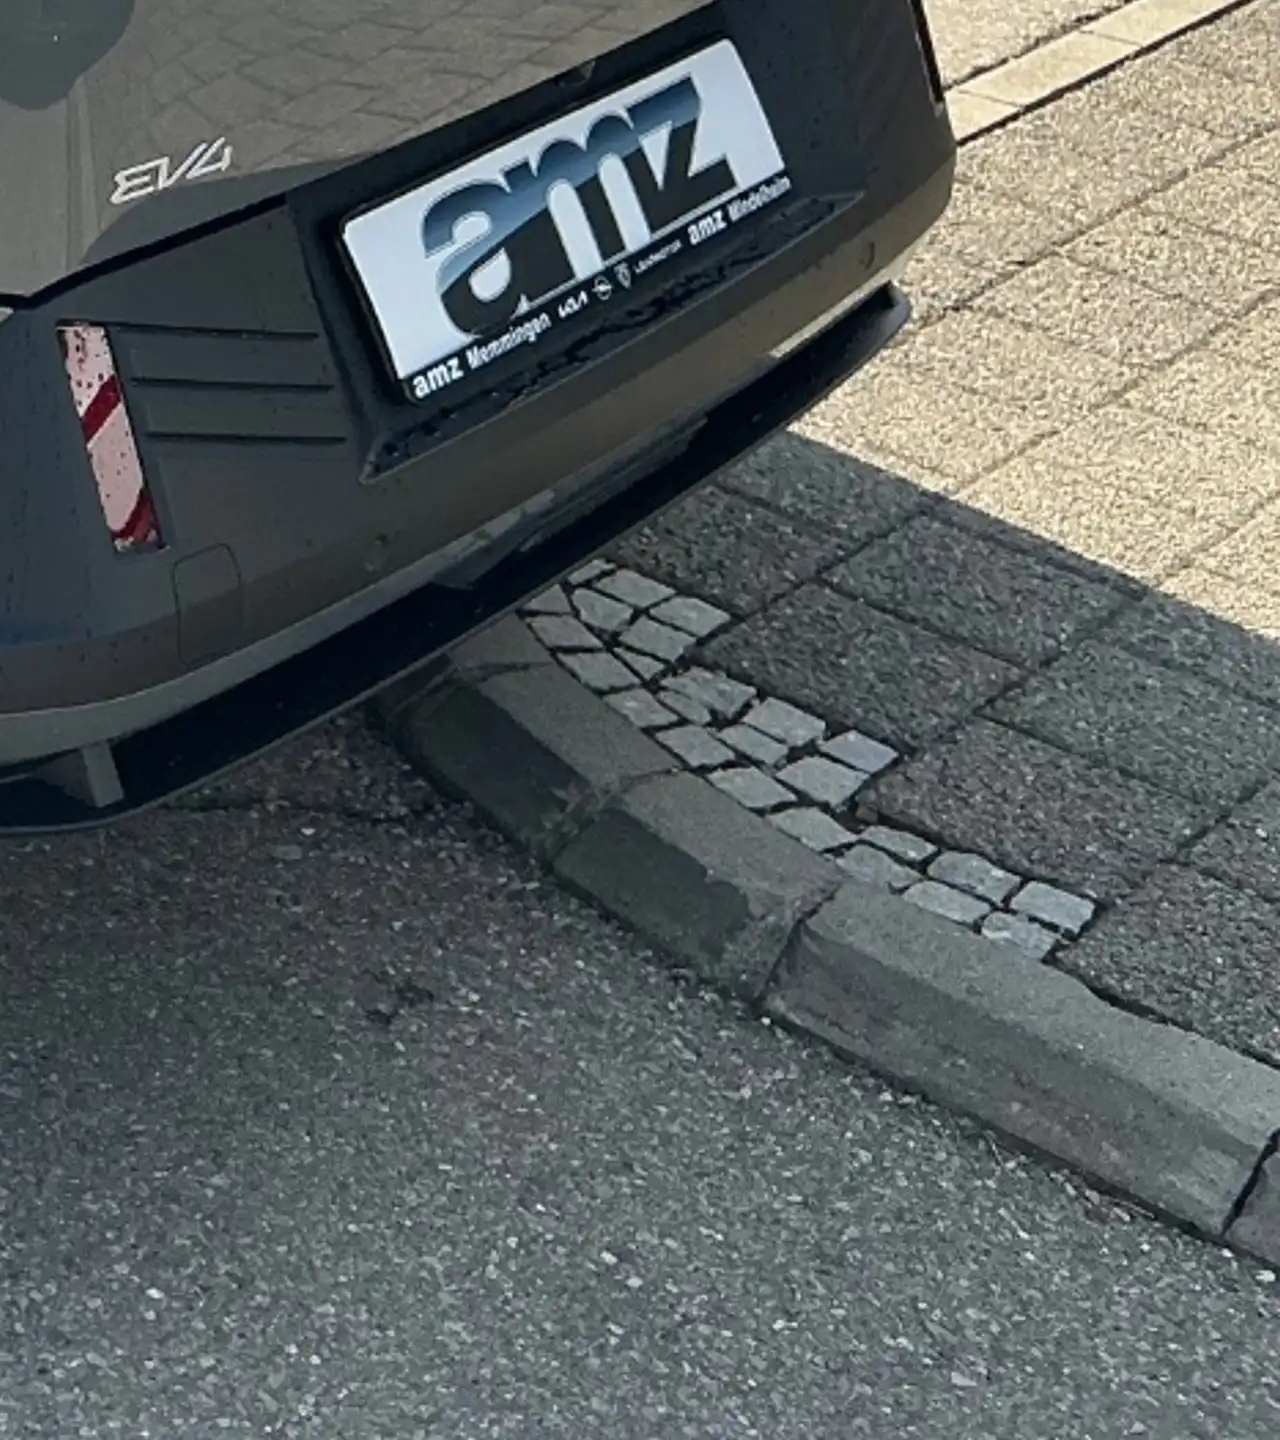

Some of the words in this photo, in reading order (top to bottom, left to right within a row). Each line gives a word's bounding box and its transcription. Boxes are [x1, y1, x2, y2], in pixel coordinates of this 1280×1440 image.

[109, 136, 234, 204] EV4
[421, 71, 741, 339] amz
[412, 355, 465, 400] amz
[465, 311, 553, 369] Memmingen
[687, 209, 728, 246] amz
[726, 175, 792, 223] Mindelheim
